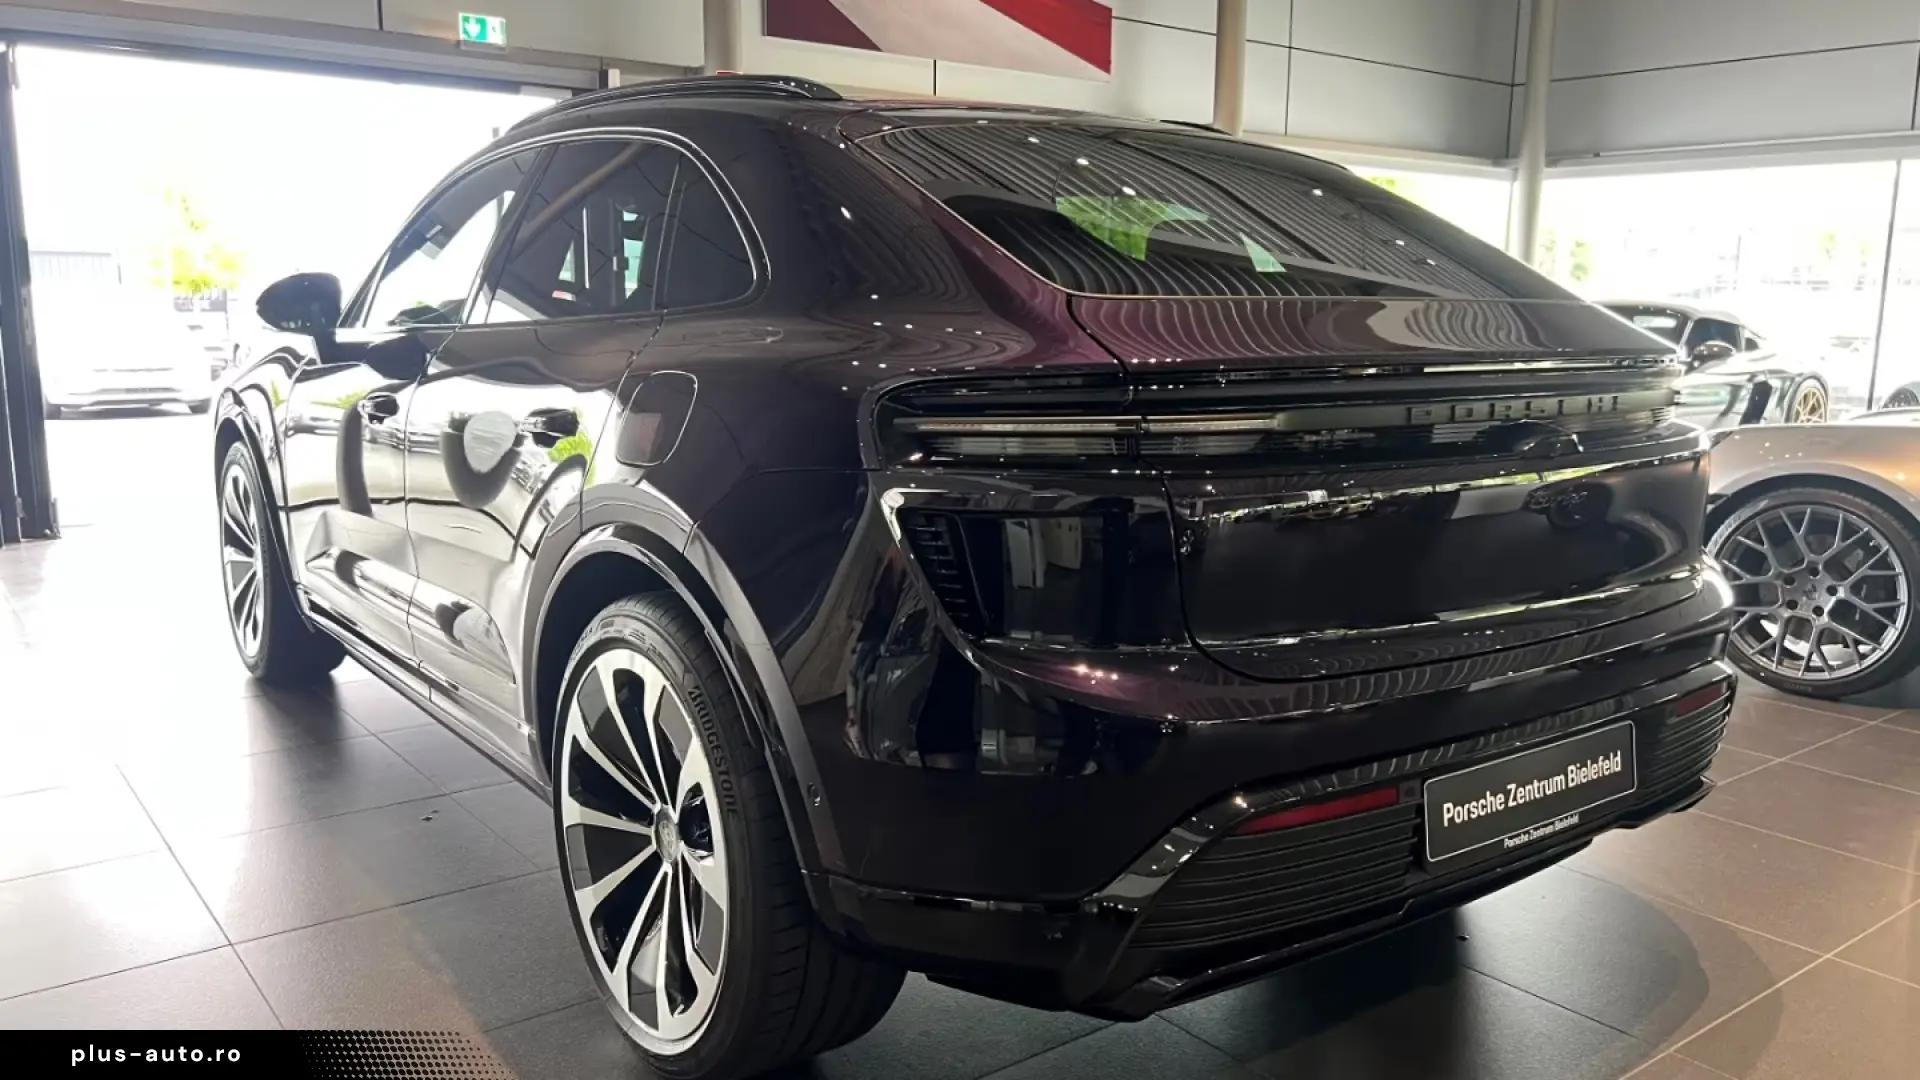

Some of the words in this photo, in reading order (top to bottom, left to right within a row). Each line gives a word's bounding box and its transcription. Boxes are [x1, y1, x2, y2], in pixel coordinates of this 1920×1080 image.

[688, 685, 739, 815] BRIDGESTONE
[1443, 790, 1505, 827] Porsche
[1506, 773, 1566, 808] Zentrum
[1567, 750, 1622, 788] Bielefeld
[1504, 833, 1529, 849] Porsche
[1530, 825, 1554, 841] Zentrum
[1555, 813, 1579, 831] Bielefeld
